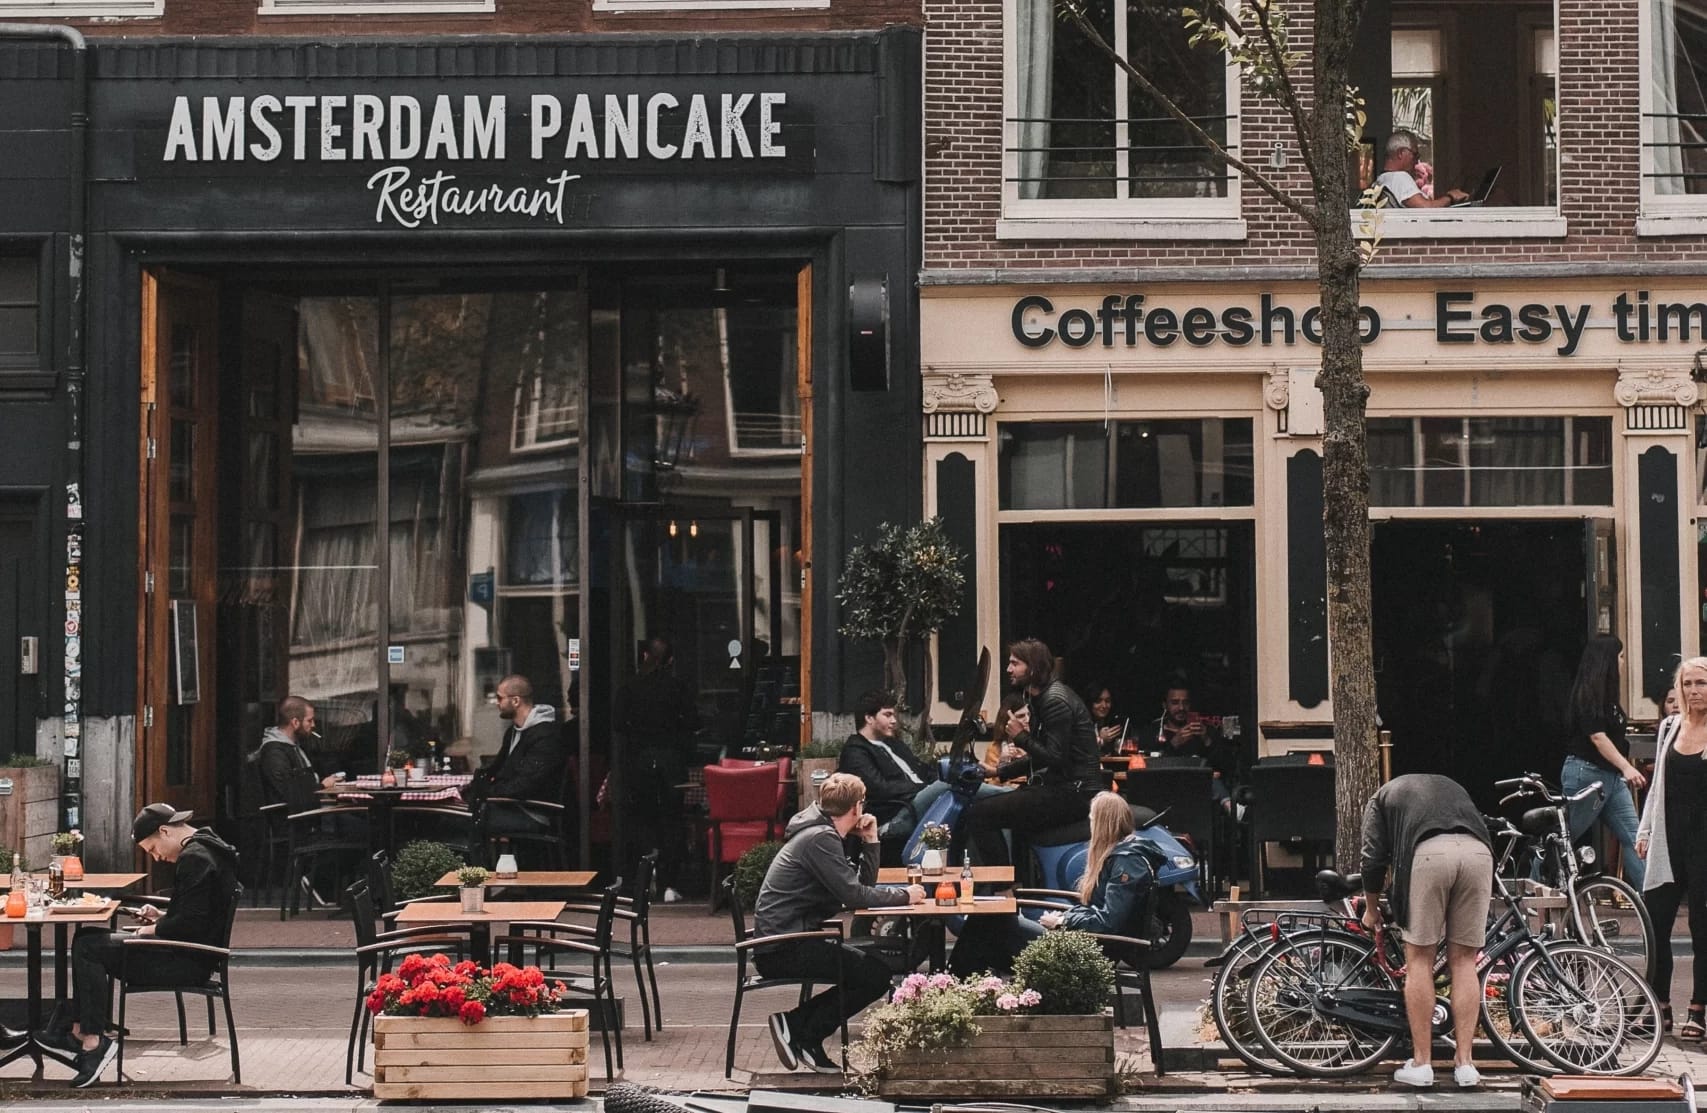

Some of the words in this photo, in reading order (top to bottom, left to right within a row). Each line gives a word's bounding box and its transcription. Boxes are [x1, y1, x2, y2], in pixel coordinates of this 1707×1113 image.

[163, 94, 507, 161] AMSTERDAM
[531, 92, 787, 160] PANCAKE
[366, 166, 581, 228] Restaurant
[1435, 291, 1591, 357] Easy
[1612, 290, 1707, 342] tim
